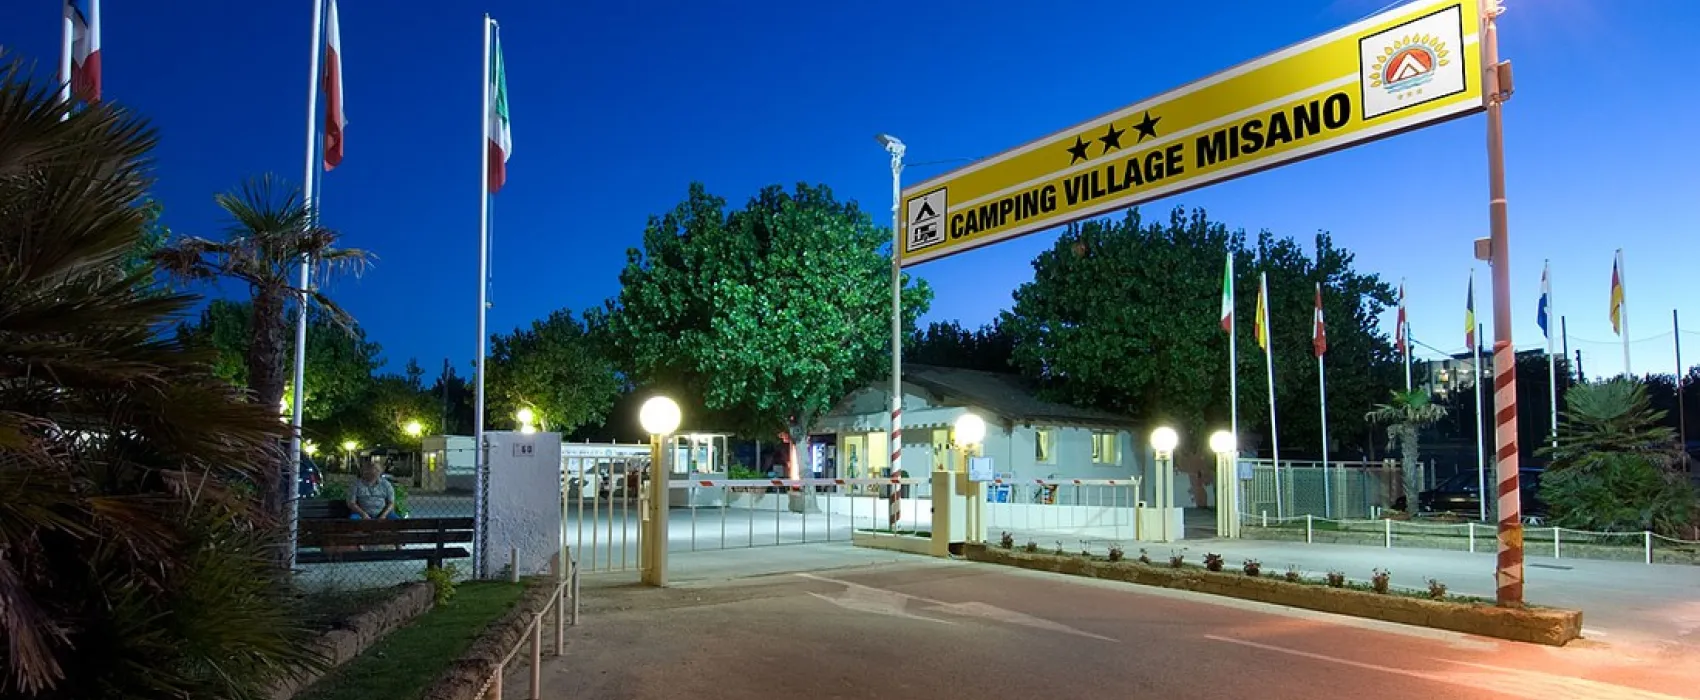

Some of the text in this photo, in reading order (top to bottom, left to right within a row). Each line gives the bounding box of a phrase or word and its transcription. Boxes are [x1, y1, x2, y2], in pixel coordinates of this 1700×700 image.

[951, 93, 1350, 240] CAMPING VILLAGE MISANO
